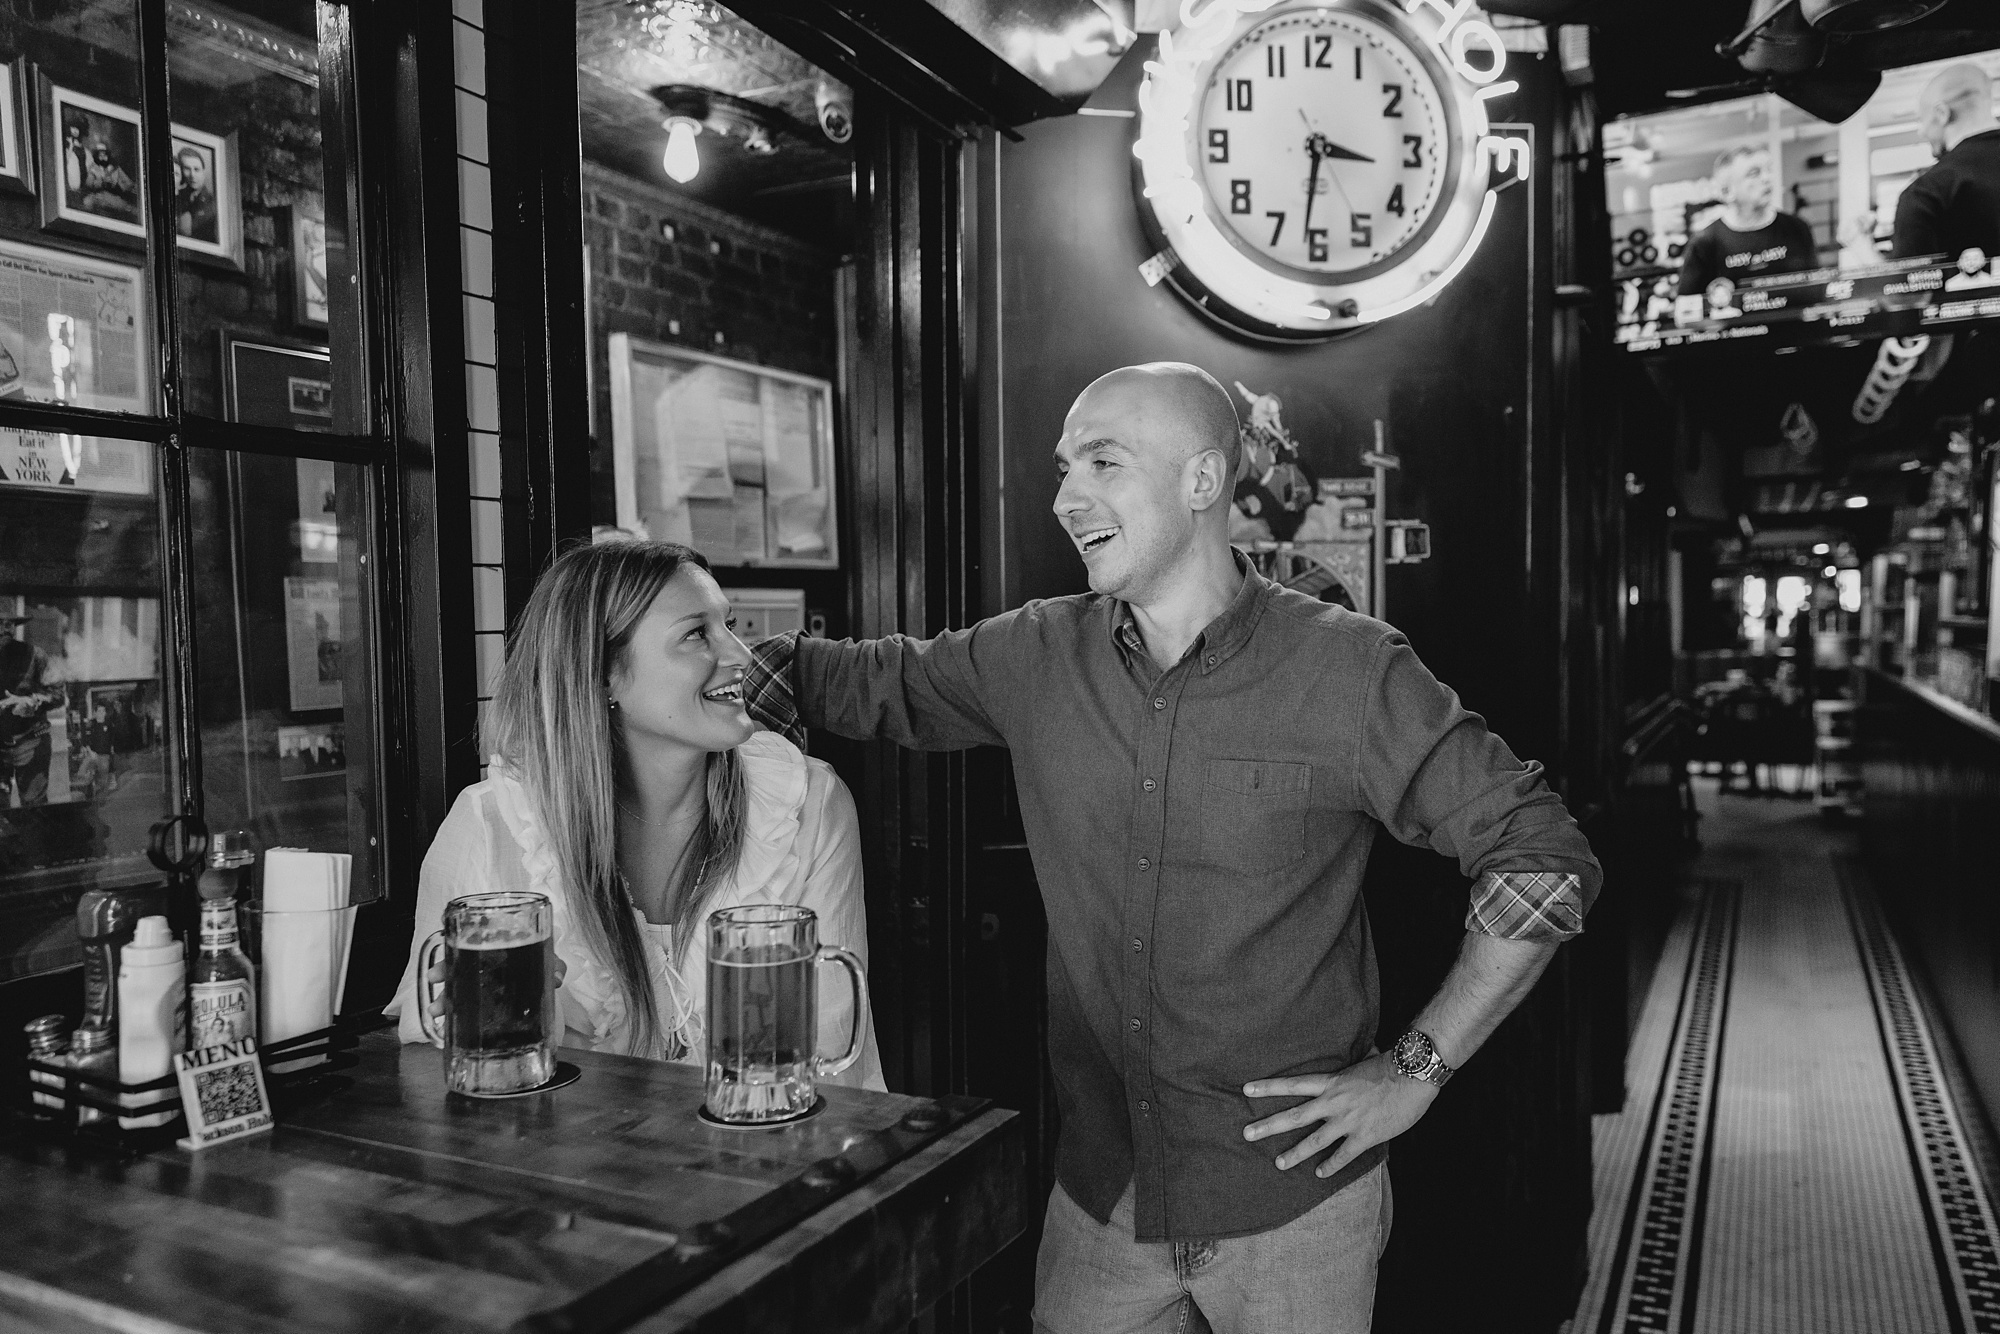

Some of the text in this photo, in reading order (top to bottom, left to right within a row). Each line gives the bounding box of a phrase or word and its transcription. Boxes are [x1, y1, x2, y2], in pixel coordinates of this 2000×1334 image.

[1267, 45, 1286, 78] 11
[1304, 34, 1333, 69] 12
[1355, 46, 1363, 80] 1
[1226, 79, 1253, 111] 10
[1382, 83, 1403, 118] 2
[1208, 128, 1230, 164] 9
[1402, 135, 1423, 169] 3
[1230, 179, 1252, 215] 8
[1386, 183, 1405, 217] 4
[1266, 211, 1285, 247] 7
[1308, 228, 1329, 262] 6
[1350, 212, 1373, 248] 5
[19, 436, 45, 449] Eat it
[15, 468, 52, 483] YORK
[19, 456, 47, 469] NEW
[181, 1035, 258, 1070] MENU
